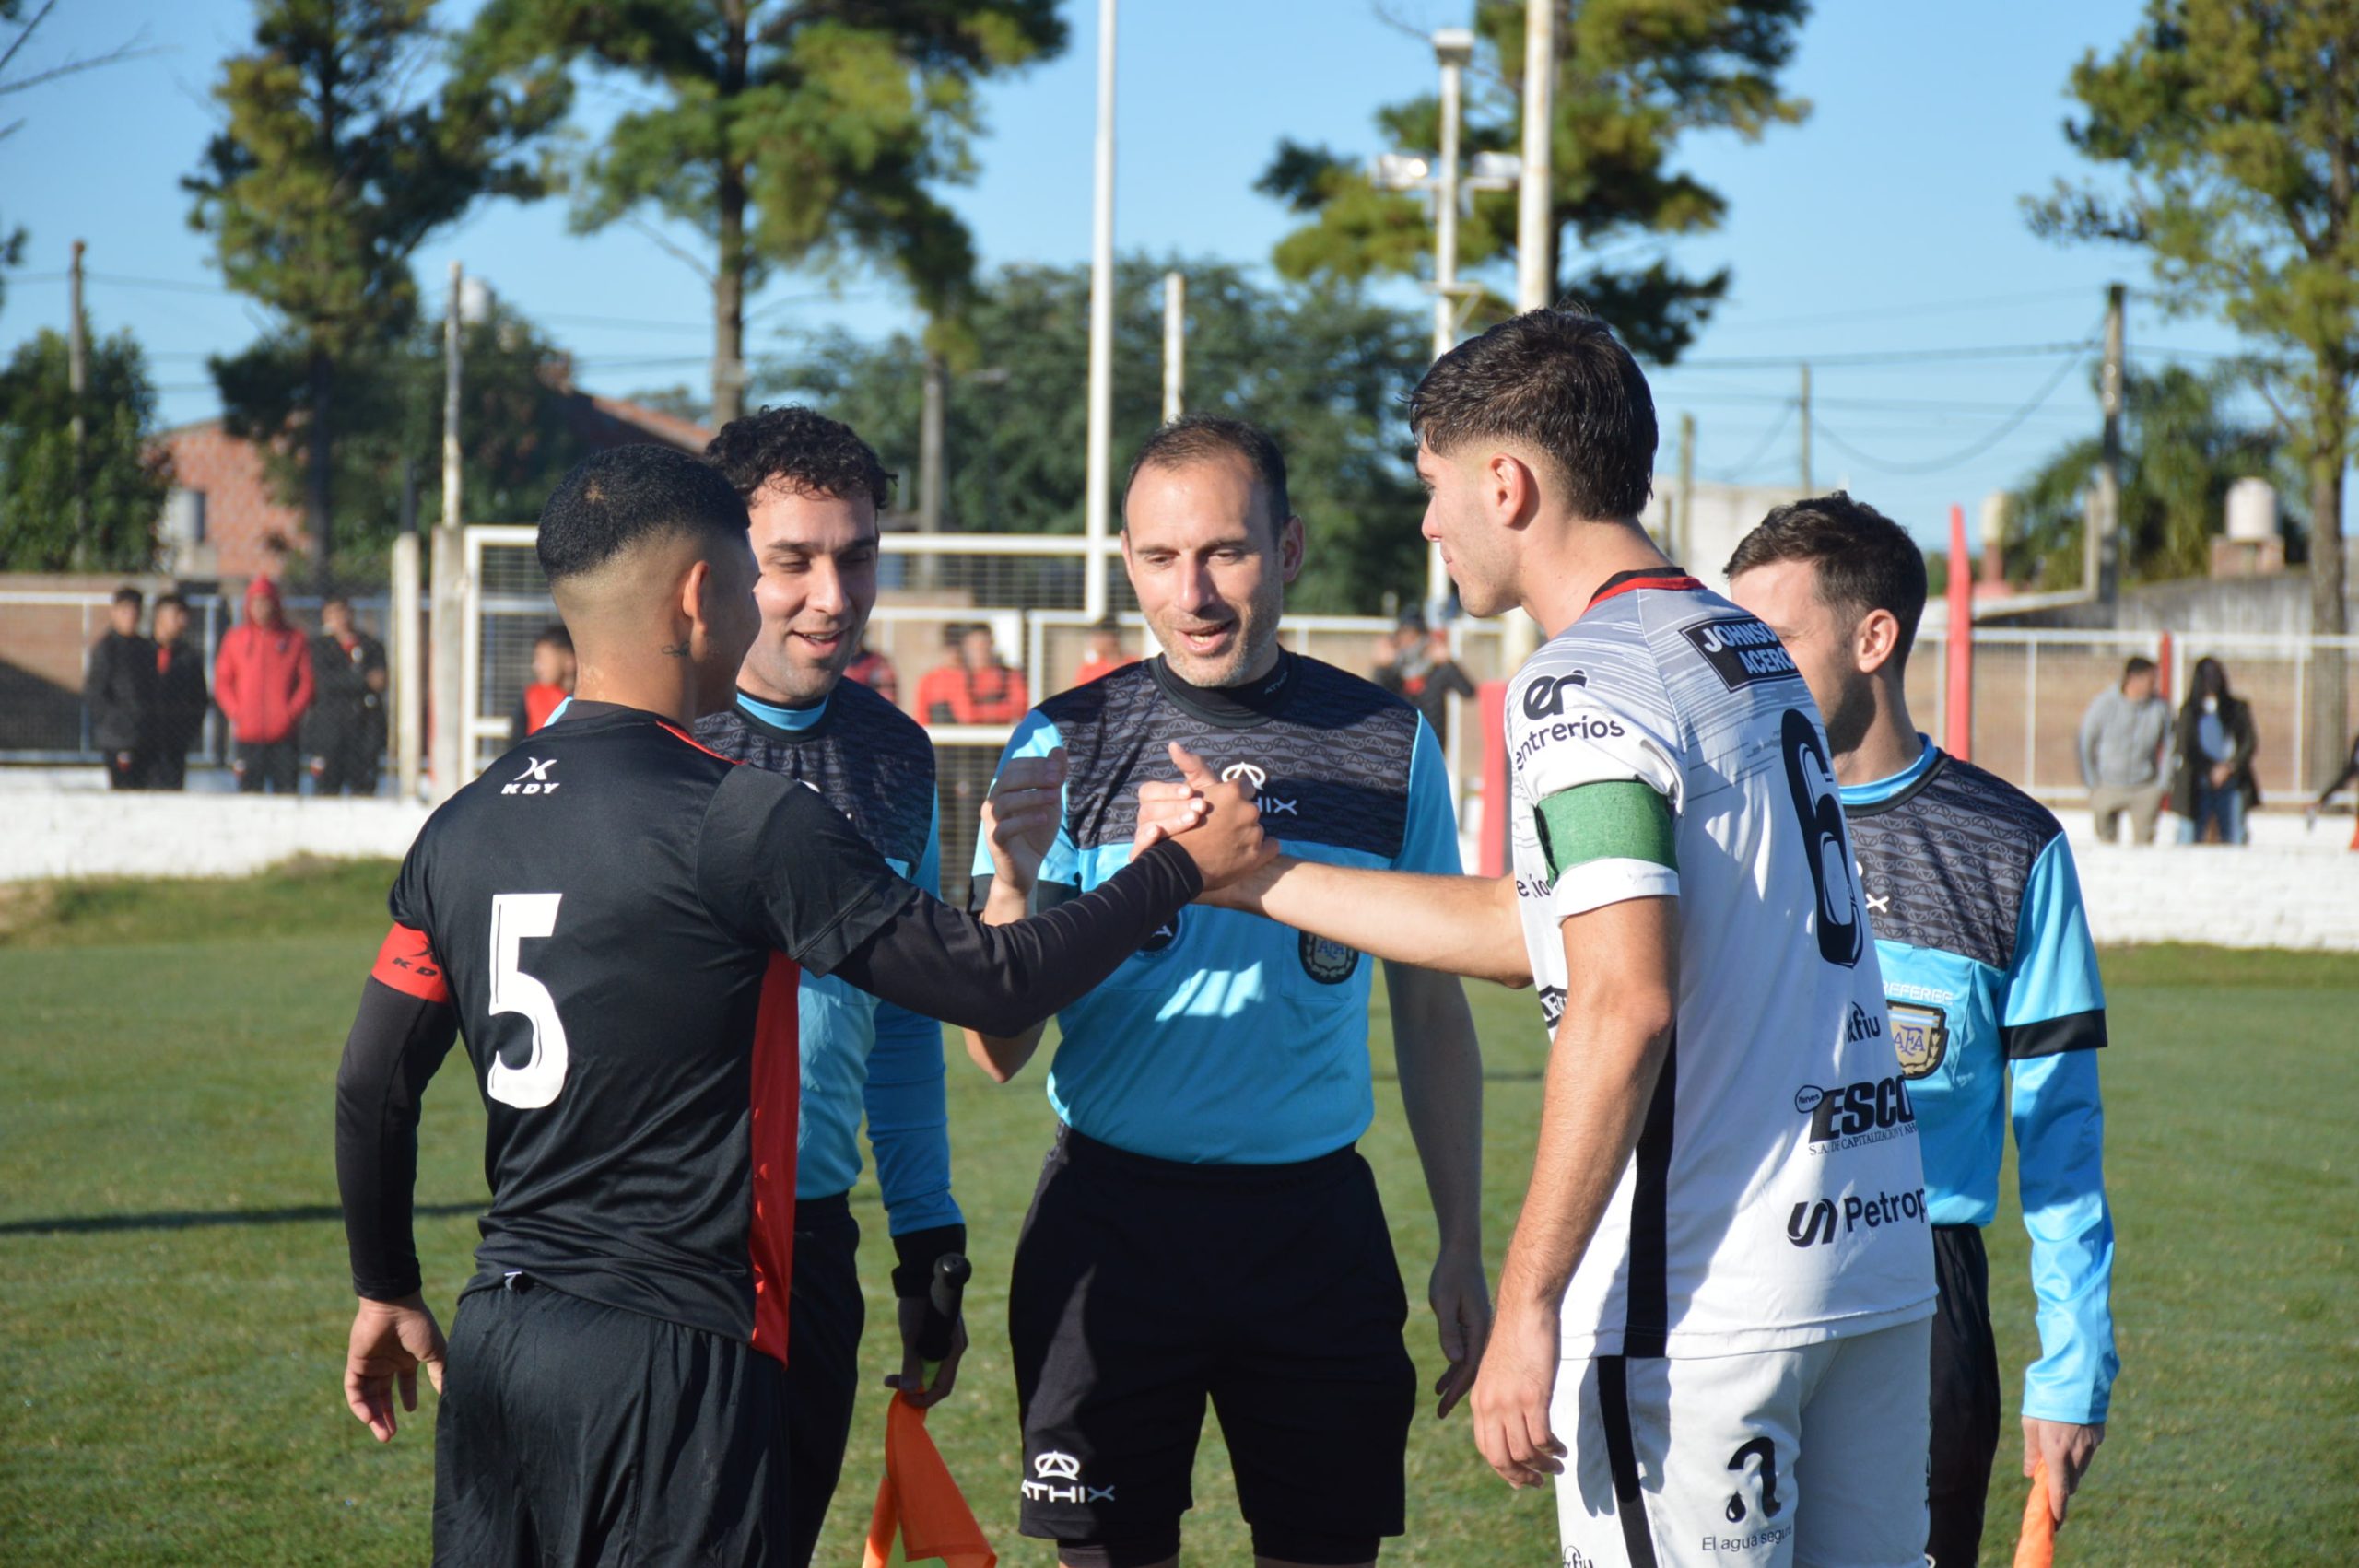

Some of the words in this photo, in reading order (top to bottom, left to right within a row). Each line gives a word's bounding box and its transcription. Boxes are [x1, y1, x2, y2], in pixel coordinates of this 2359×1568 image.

[501, 783, 560, 794] KDY
[1781, 708, 1863, 969] 6
[487, 893, 569, 1109] 5
[1021, 1479, 1115, 1504] ATHIX
[1702, 1535, 1716, 1551] El
[1721, 1535, 1757, 1552] agua
